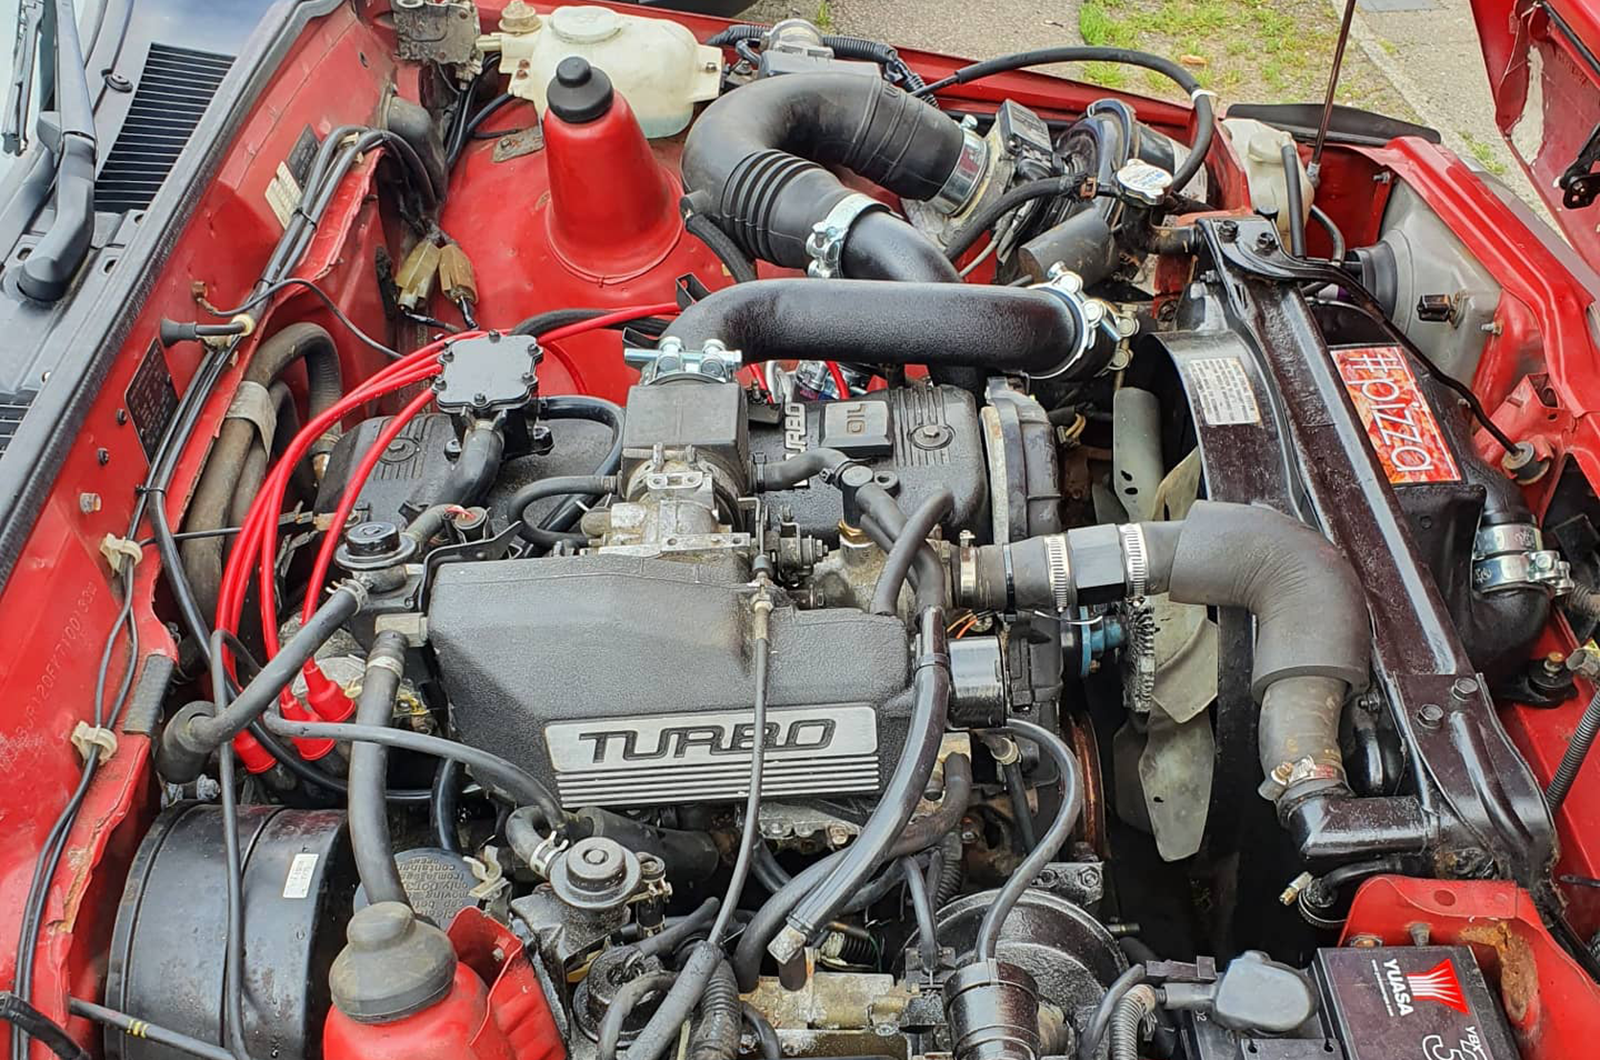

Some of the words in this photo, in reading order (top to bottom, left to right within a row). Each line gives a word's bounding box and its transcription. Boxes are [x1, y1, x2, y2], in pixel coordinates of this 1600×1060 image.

[846, 404, 866, 434] OIL
[1347, 354, 1434, 471] #pizza
[579, 718, 836, 763] TURBO
[1383, 959, 1414, 1017] YUASA
[1465, 1026, 1482, 1052] YBX
